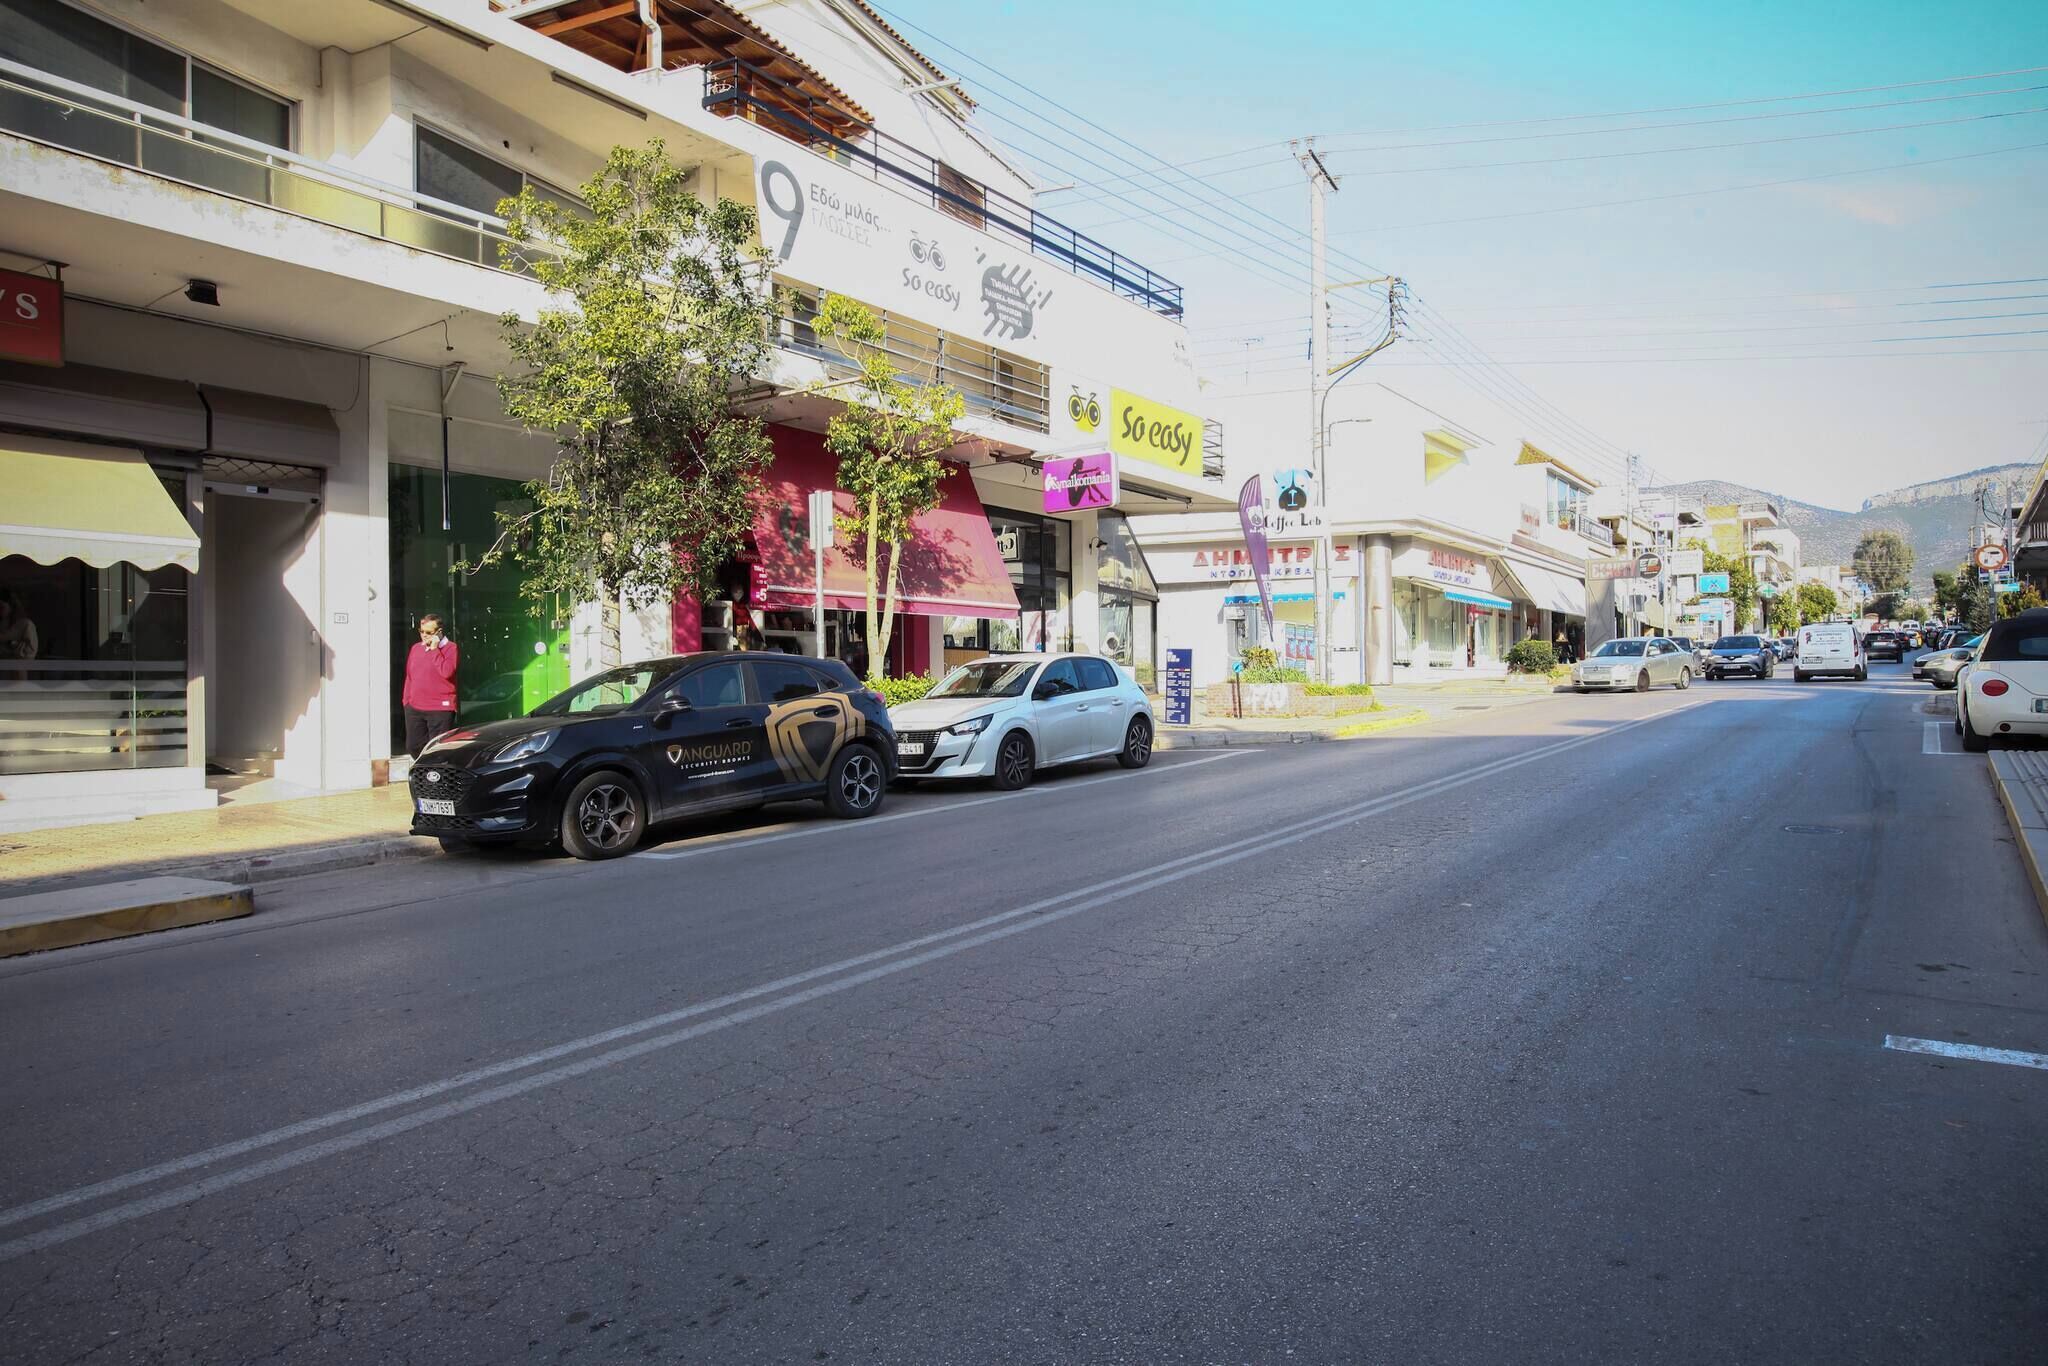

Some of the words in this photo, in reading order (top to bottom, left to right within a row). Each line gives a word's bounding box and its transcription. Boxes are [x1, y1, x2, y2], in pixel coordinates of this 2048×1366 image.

[761, 160, 805, 260] 9
[810, 182, 840, 211] Εδώ
[902, 267, 921, 291] So
[924, 280, 961, 313] easy
[1121, 406, 1146, 443] So
[1149, 422, 1193, 467] easy
[1193, 545, 1350, 568] ΔΗΜΤΡΣ
[1210, 567, 1253, 579] ΝΤΟΠΙ
[680, 760, 718, 770] SECURITY
